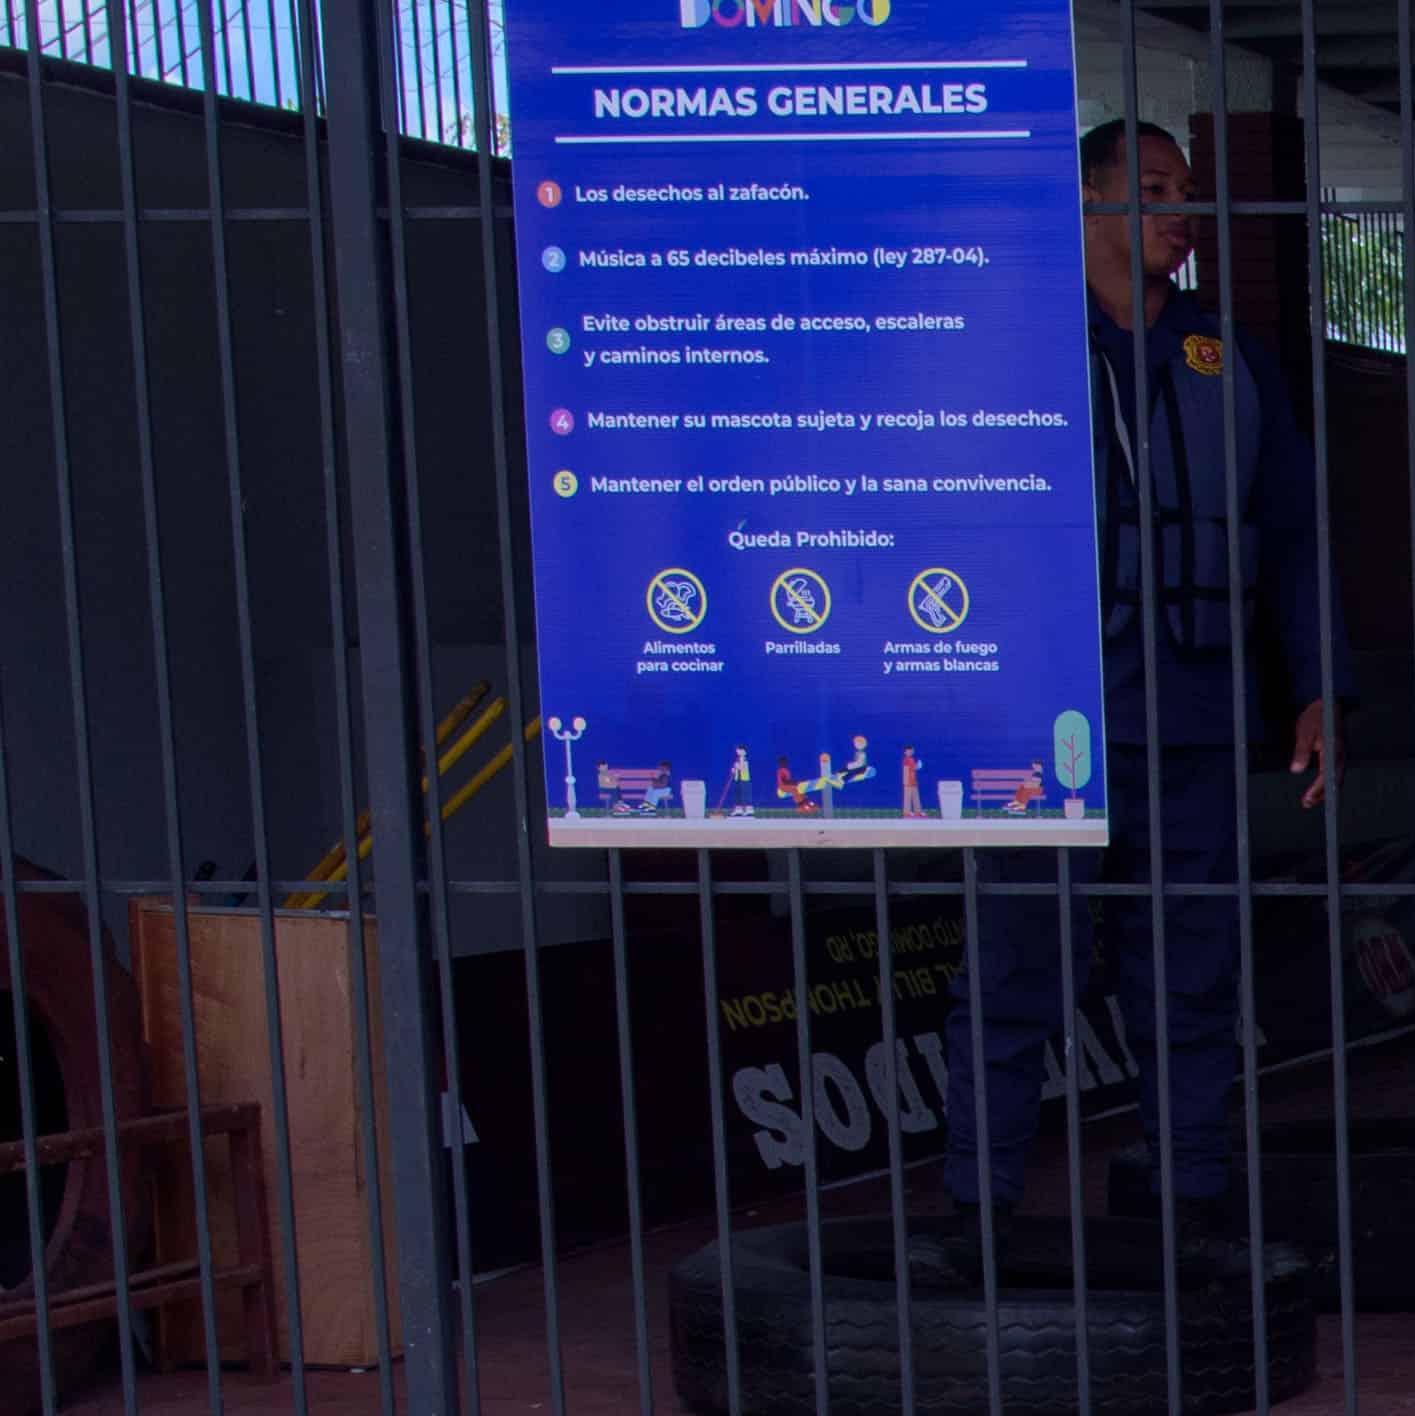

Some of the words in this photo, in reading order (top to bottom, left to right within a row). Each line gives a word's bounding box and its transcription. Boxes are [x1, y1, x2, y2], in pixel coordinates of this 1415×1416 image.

[680, 0, 891, 28] DOMINGO
[595, 87, 758, 118] NORMAS
[767, 84, 988, 116] GENERALES
[575, 186, 609, 203] Los
[612, 184, 704, 202] desechos
[707, 183, 725, 201] al
[729, 183, 810, 201] zafacón.
[579, 249, 647, 267] Música
[650, 253, 663, 267] a
[667, 249, 691, 267] 65
[694, 248, 786, 267] decibeles
[790, 247, 869, 266] máximo
[873, 247, 908, 269] (ley
[911, 246, 990, 268] 287-04).
[583, 313, 631, 332] Evite
[634, 313, 711, 332] obstruir
[715, 314, 767, 331] áreas
[770, 313, 796, 331] de
[799, 317, 871, 333] acceso,
[875, 312, 965, 331] escaleras
[583, 351, 596, 368] y
[599, 346, 681, 364] caminos
[685, 345, 770, 364] internos.
[587, 412, 680, 429] Mantener
[683, 415, 706, 428] su
[711, 412, 793, 428] mascota
[797, 409, 856, 432] sujeta
[859, 414, 873, 432] y
[876, 409, 936, 431] recoja
[939, 409, 969, 427] los
[971, 409, 1069, 427] desechos.
[591, 476, 683, 493] Mantener
[686, 475, 704, 493] el
[708, 475, 765, 493] orden
[769, 474, 841, 496] público
[844, 479, 857, 496] y
[861, 474, 879, 492] la
[882, 478, 929, 492] sana
[932, 473, 1052, 492] convivencia.
[728, 530, 792, 551] Queda
[796, 529, 895, 547] Prohibido:
[643, 640, 716, 655] Alimentos
[765, 640, 841, 654] Parrilladas
[883, 641, 931, 654] Armas
[933, 640, 953, 654] de
[955, 640, 998, 657] fuego
[636, 661, 669, 675] para
[671, 658, 725, 672] cocinar
[883, 661, 893, 674] y
[895, 661, 941, 672] armas
[943, 658, 1000, 672] blancas
